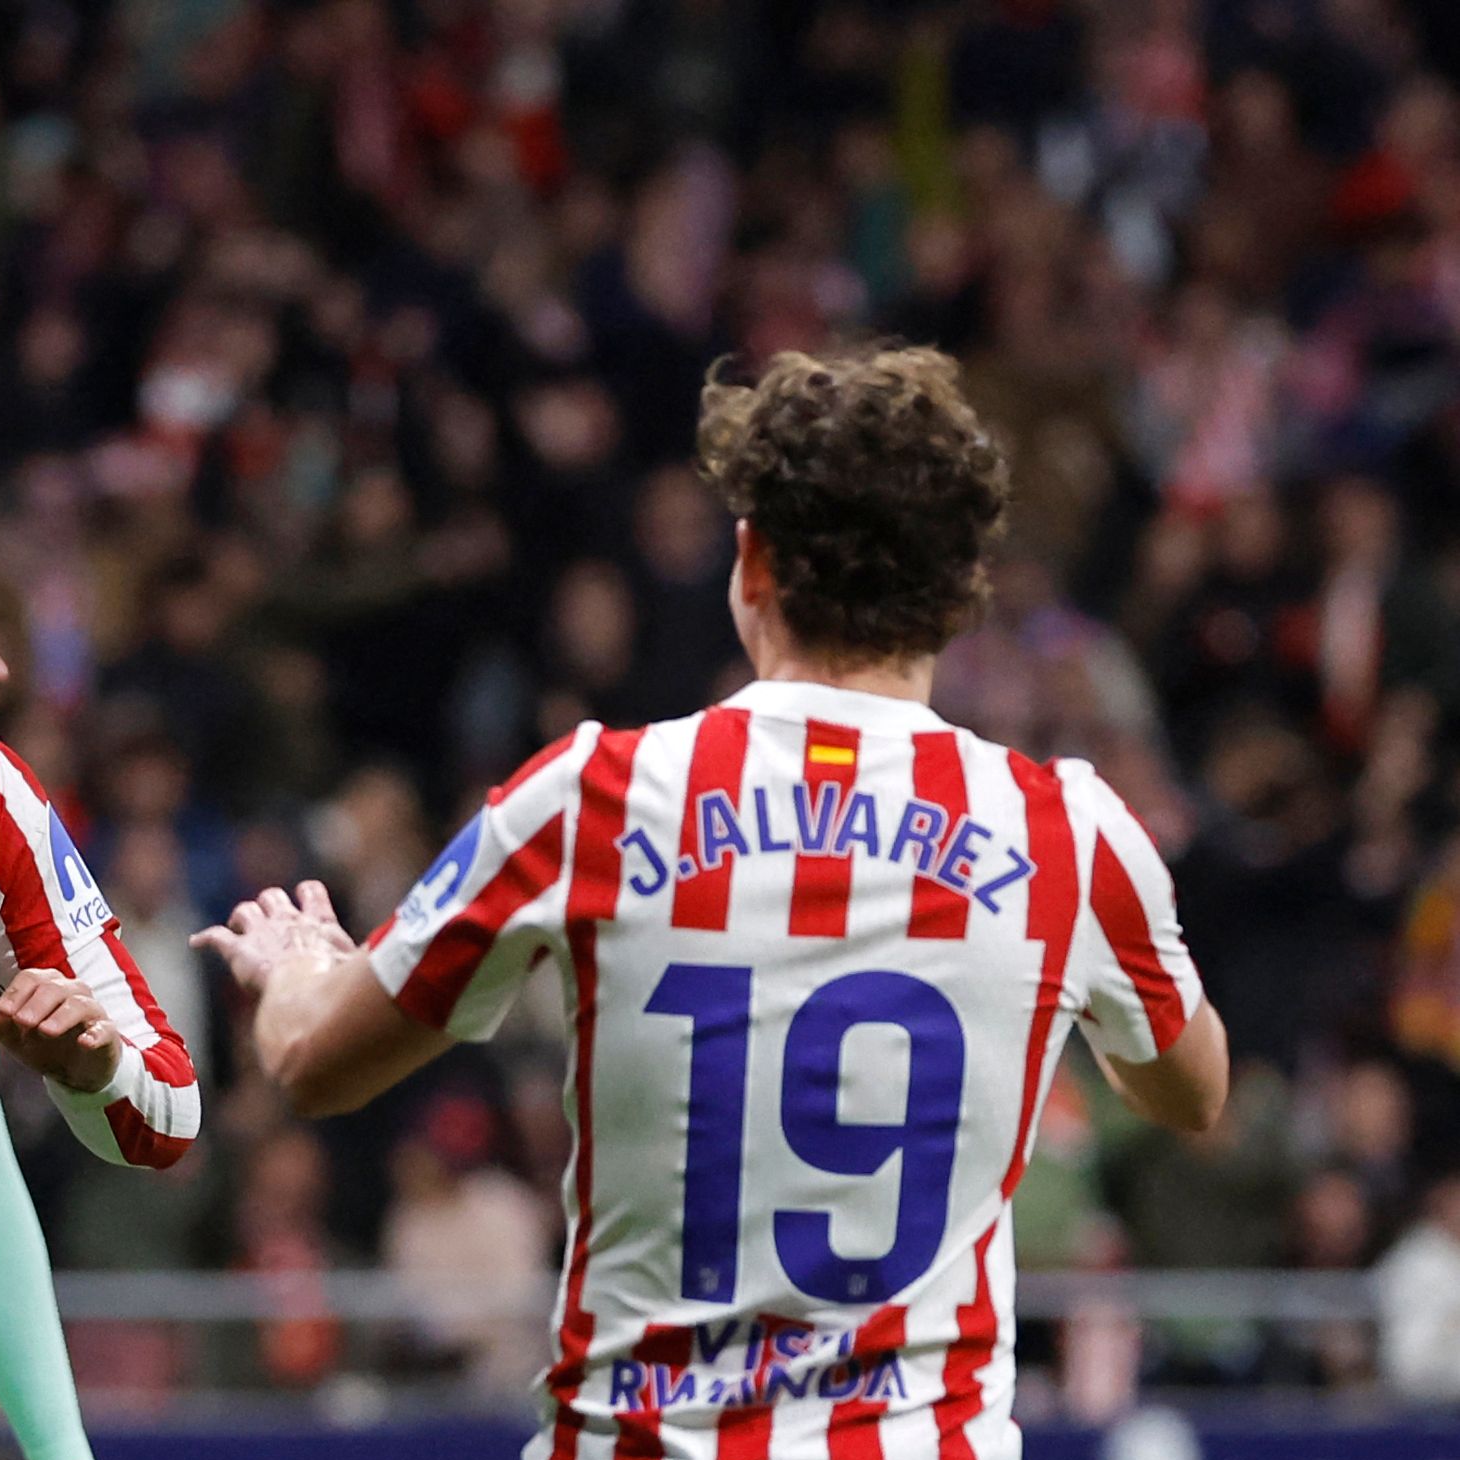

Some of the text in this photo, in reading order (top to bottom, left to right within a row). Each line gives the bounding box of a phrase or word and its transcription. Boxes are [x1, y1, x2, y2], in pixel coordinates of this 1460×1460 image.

[615, 781, 1037, 915] J.ALVAREZ
[644, 962, 966, 1304] 19
[695, 1311, 856, 1368] VIS
